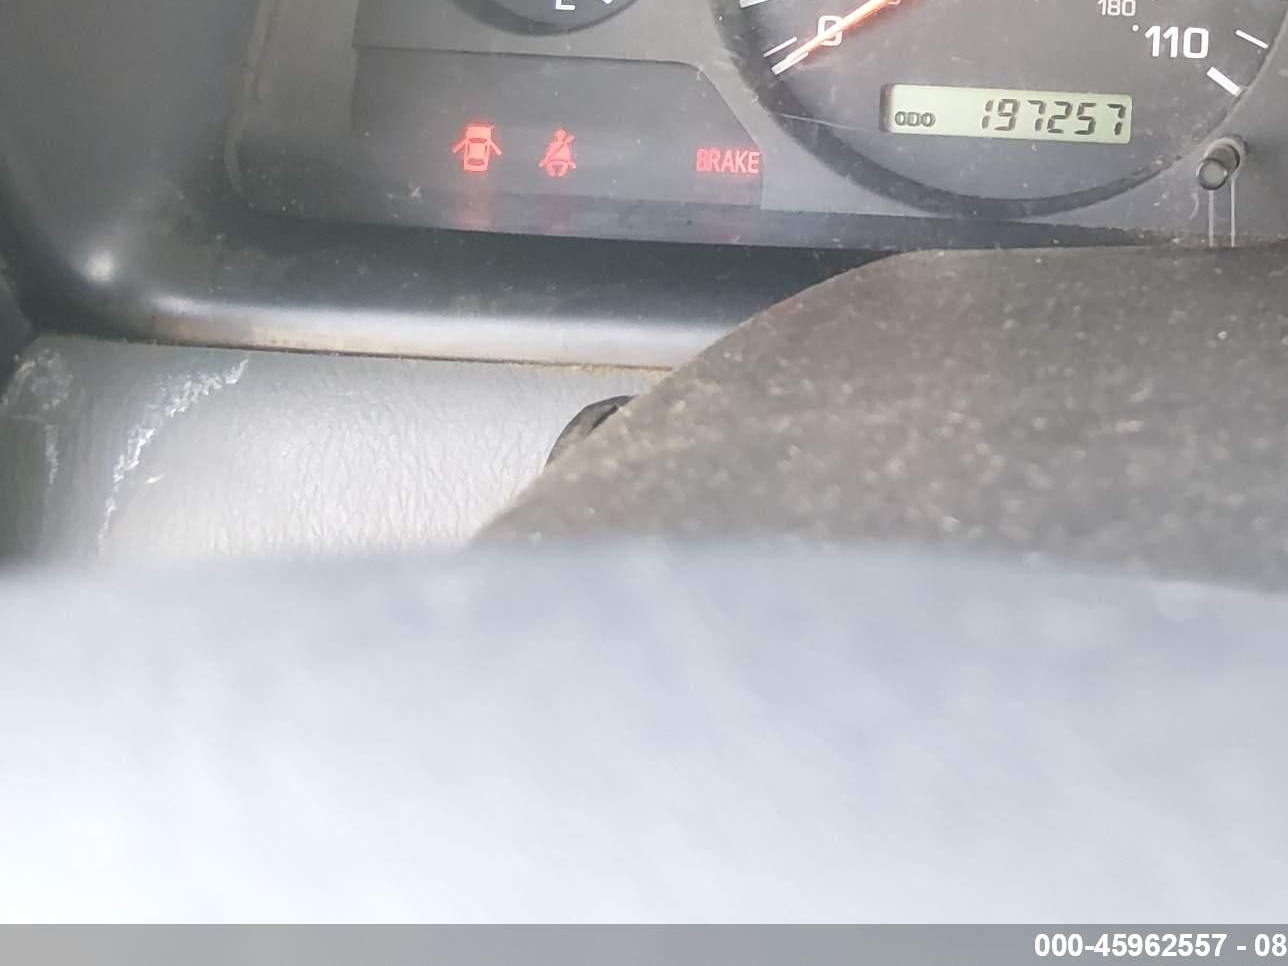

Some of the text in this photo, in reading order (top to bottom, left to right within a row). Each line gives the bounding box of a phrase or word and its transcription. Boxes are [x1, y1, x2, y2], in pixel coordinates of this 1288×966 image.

[817, 15, 843, 47] 0
[1144, 27, 1209, 59] 110
[895, 98, 1126, 136] ODO 197257
[695, 149, 760, 173] BRAKE
